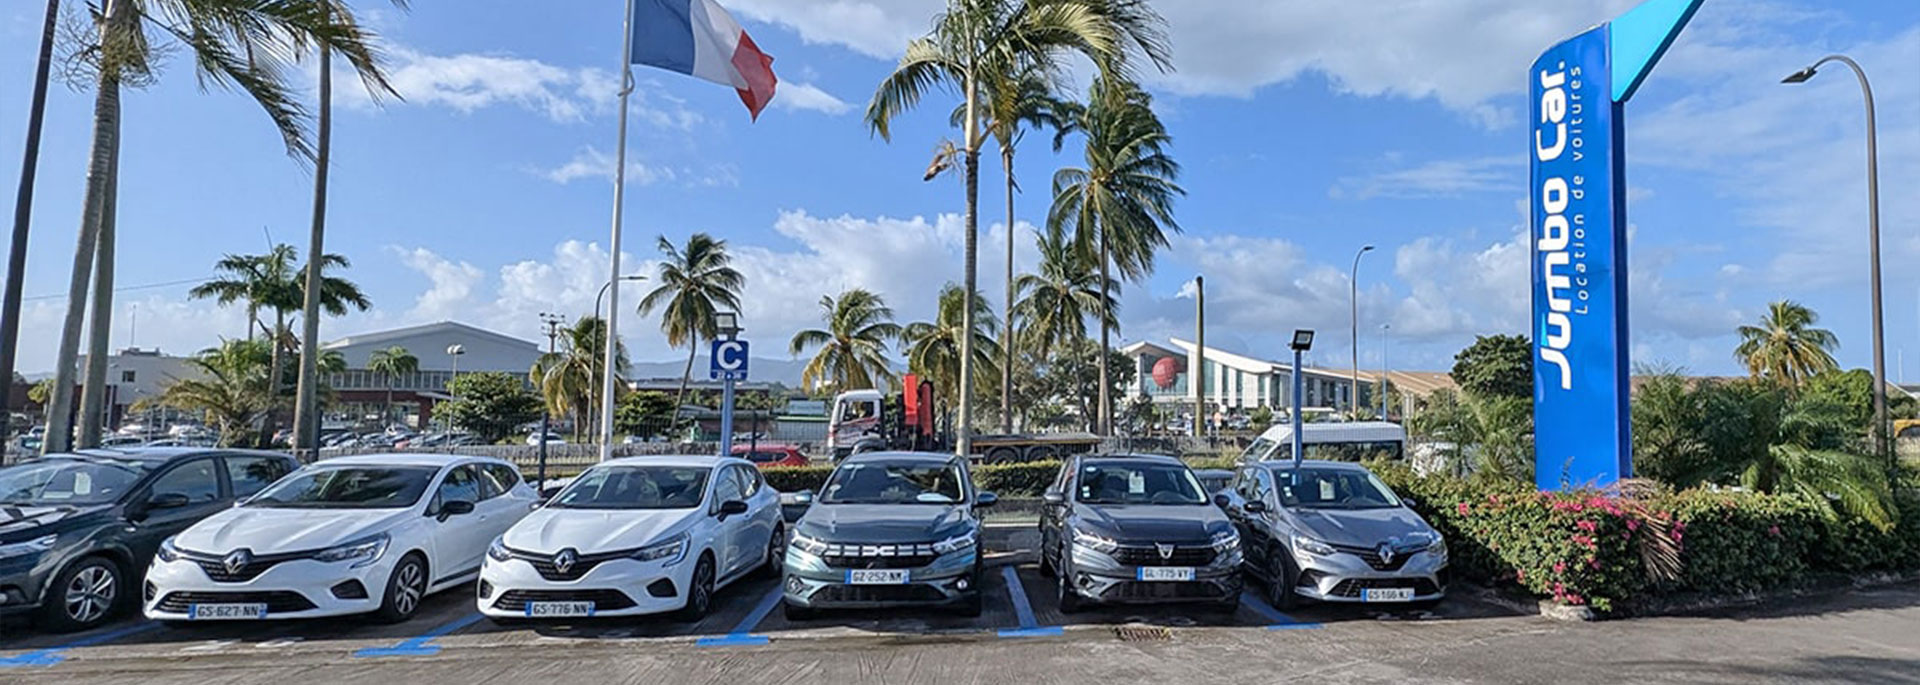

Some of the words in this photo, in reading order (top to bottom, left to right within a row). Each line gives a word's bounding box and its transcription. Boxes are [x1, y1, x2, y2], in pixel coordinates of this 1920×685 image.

[1569, 66, 1584, 161] voitures
[1571, 175, 1585, 199] de
[1538, 177, 1572, 390] Jumbo
[1573, 214, 1589, 314] Location
[717, 342, 742, 370] C
